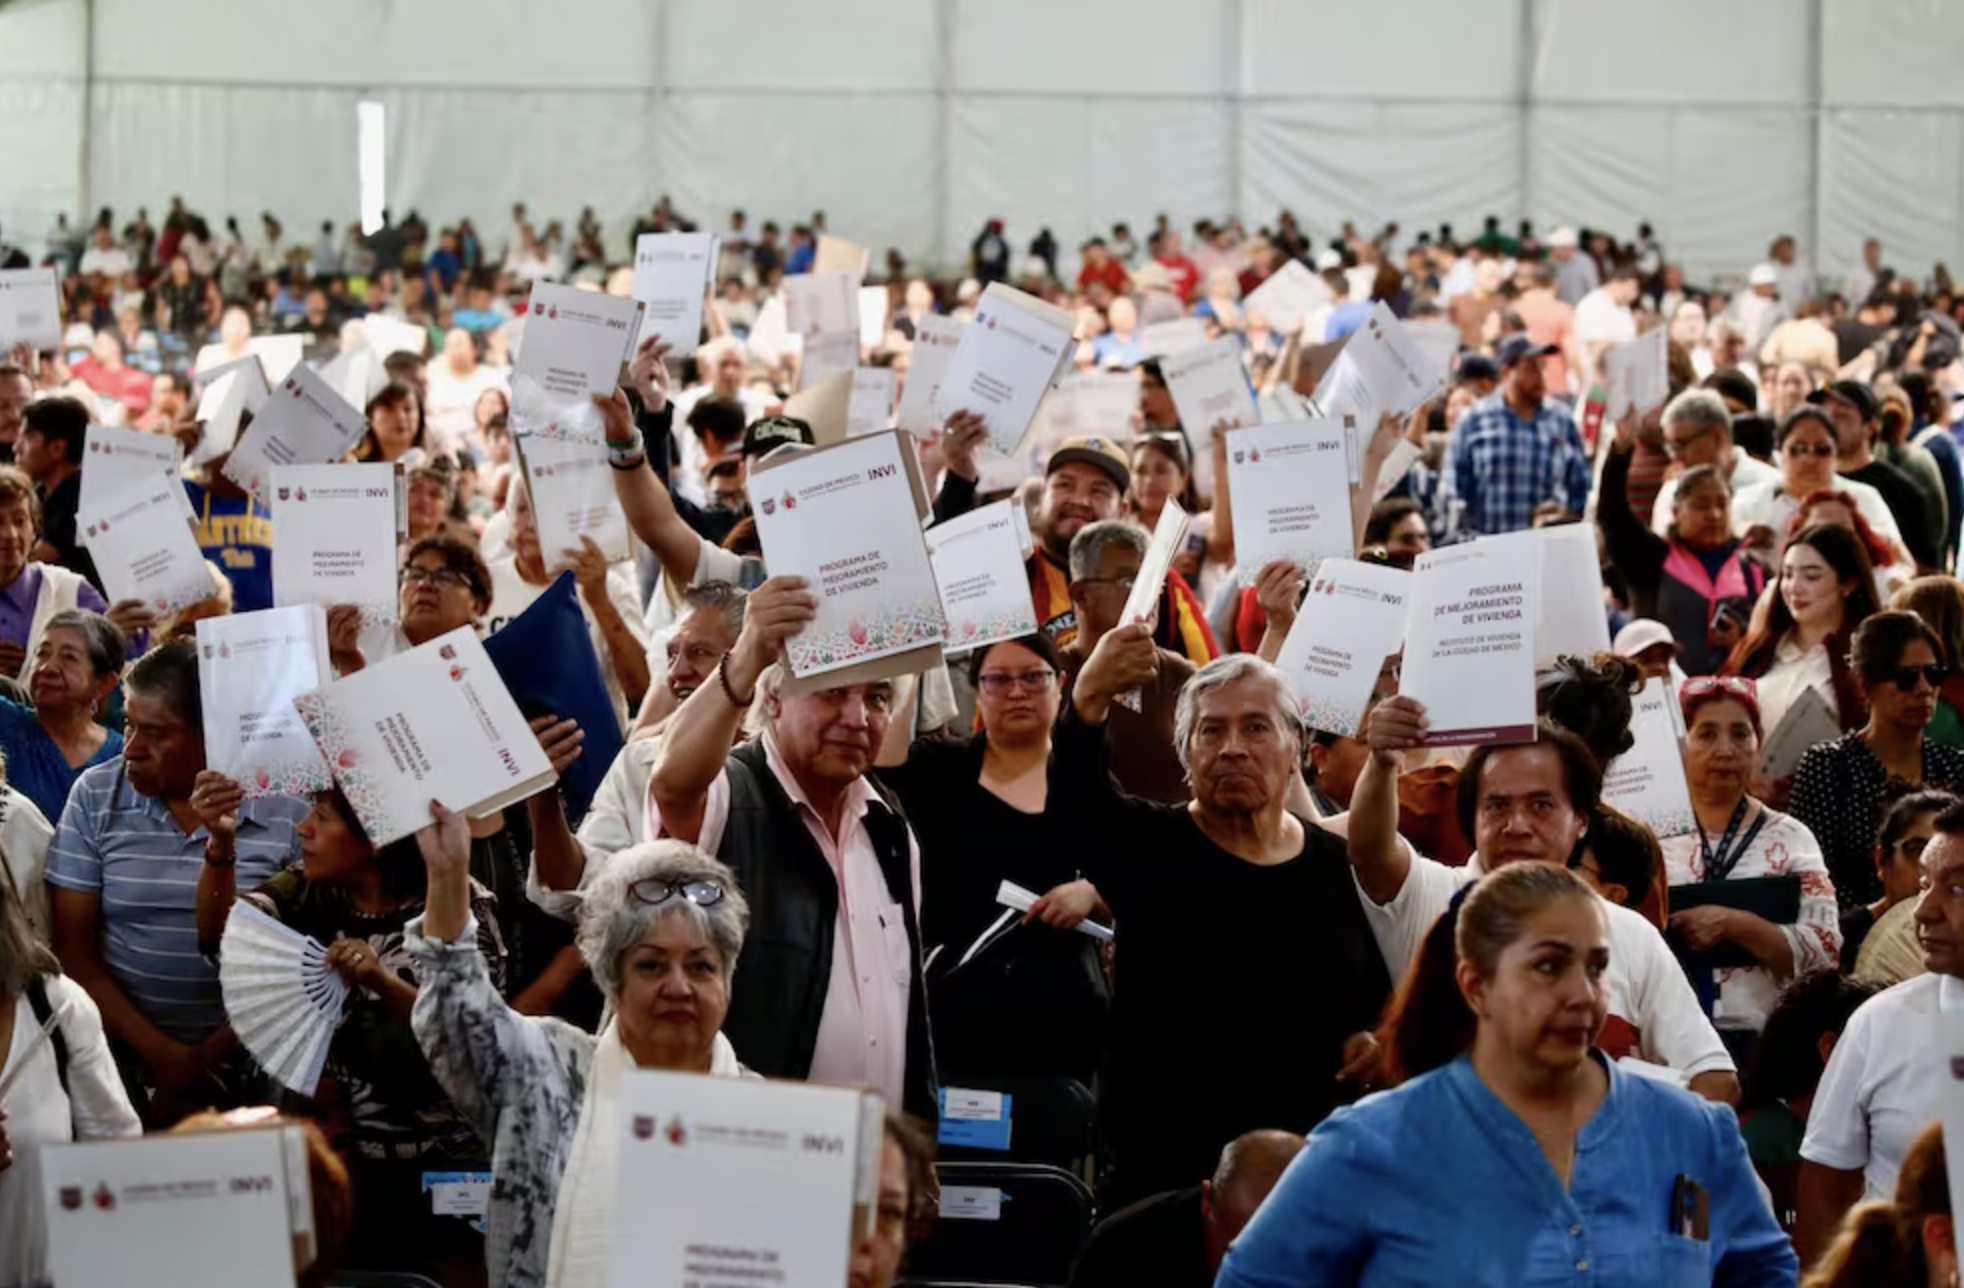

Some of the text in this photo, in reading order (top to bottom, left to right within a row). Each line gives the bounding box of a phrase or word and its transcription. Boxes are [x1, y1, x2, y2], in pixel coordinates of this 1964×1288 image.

[867, 463, 898, 481] INVI
[365, 488, 389, 498] INVI
[819, 550, 881, 573] PROGRAMA DE
[822, 561, 889, 585] MEJORAMIENTO
[825, 576, 880, 598] DE VIVIENDA
[1468, 582, 1523, 597] PROGRAMA
[1435, 596, 1523, 617] DE MEJORAMIENTO
[1462, 609, 1522, 625] DE VIVIENDA
[375, 721, 407, 773] DE VIVIENDA
[385, 716, 423, 781] MEJORAMIENTO
[396, 712, 431, 772] PROGRAMA DE
[498, 748, 521, 777] INVI
